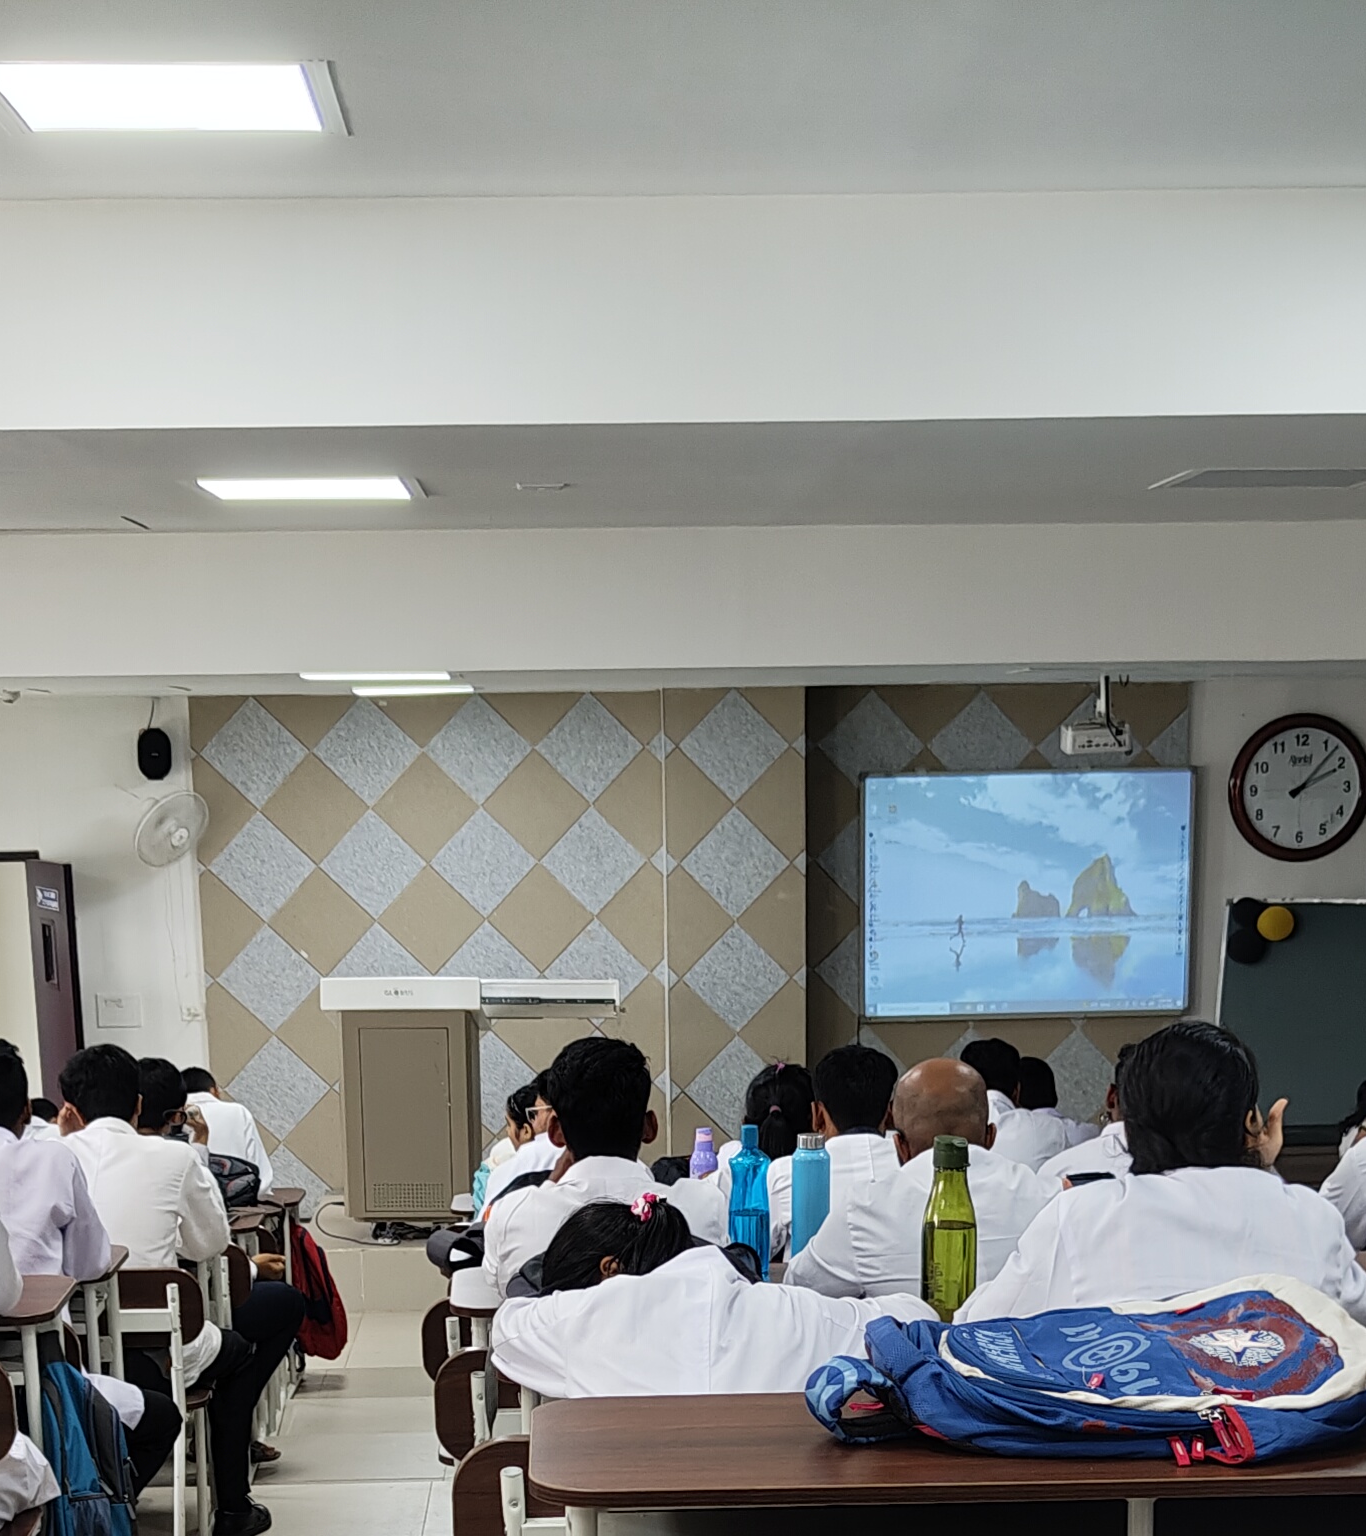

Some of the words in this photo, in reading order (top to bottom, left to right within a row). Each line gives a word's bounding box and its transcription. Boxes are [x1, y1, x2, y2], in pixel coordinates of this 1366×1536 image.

[1295, 733, 1310, 747] 12
[1323, 739, 1329, 752] 1
[1272, 741, 1285, 754] 11
[1254, 761, 1269, 774] 10
[1337, 757, 1346, 769] 2
[1249, 784, 1258, 797] 9
[1343, 780, 1351, 793] 3
[1255, 808, 1264, 821] 8
[1335, 804, 1344, 817] 4
[1272, 825, 1280, 838] 7
[1319, 823, 1327, 836] 5
[1295, 830, 1303, 843] 6
